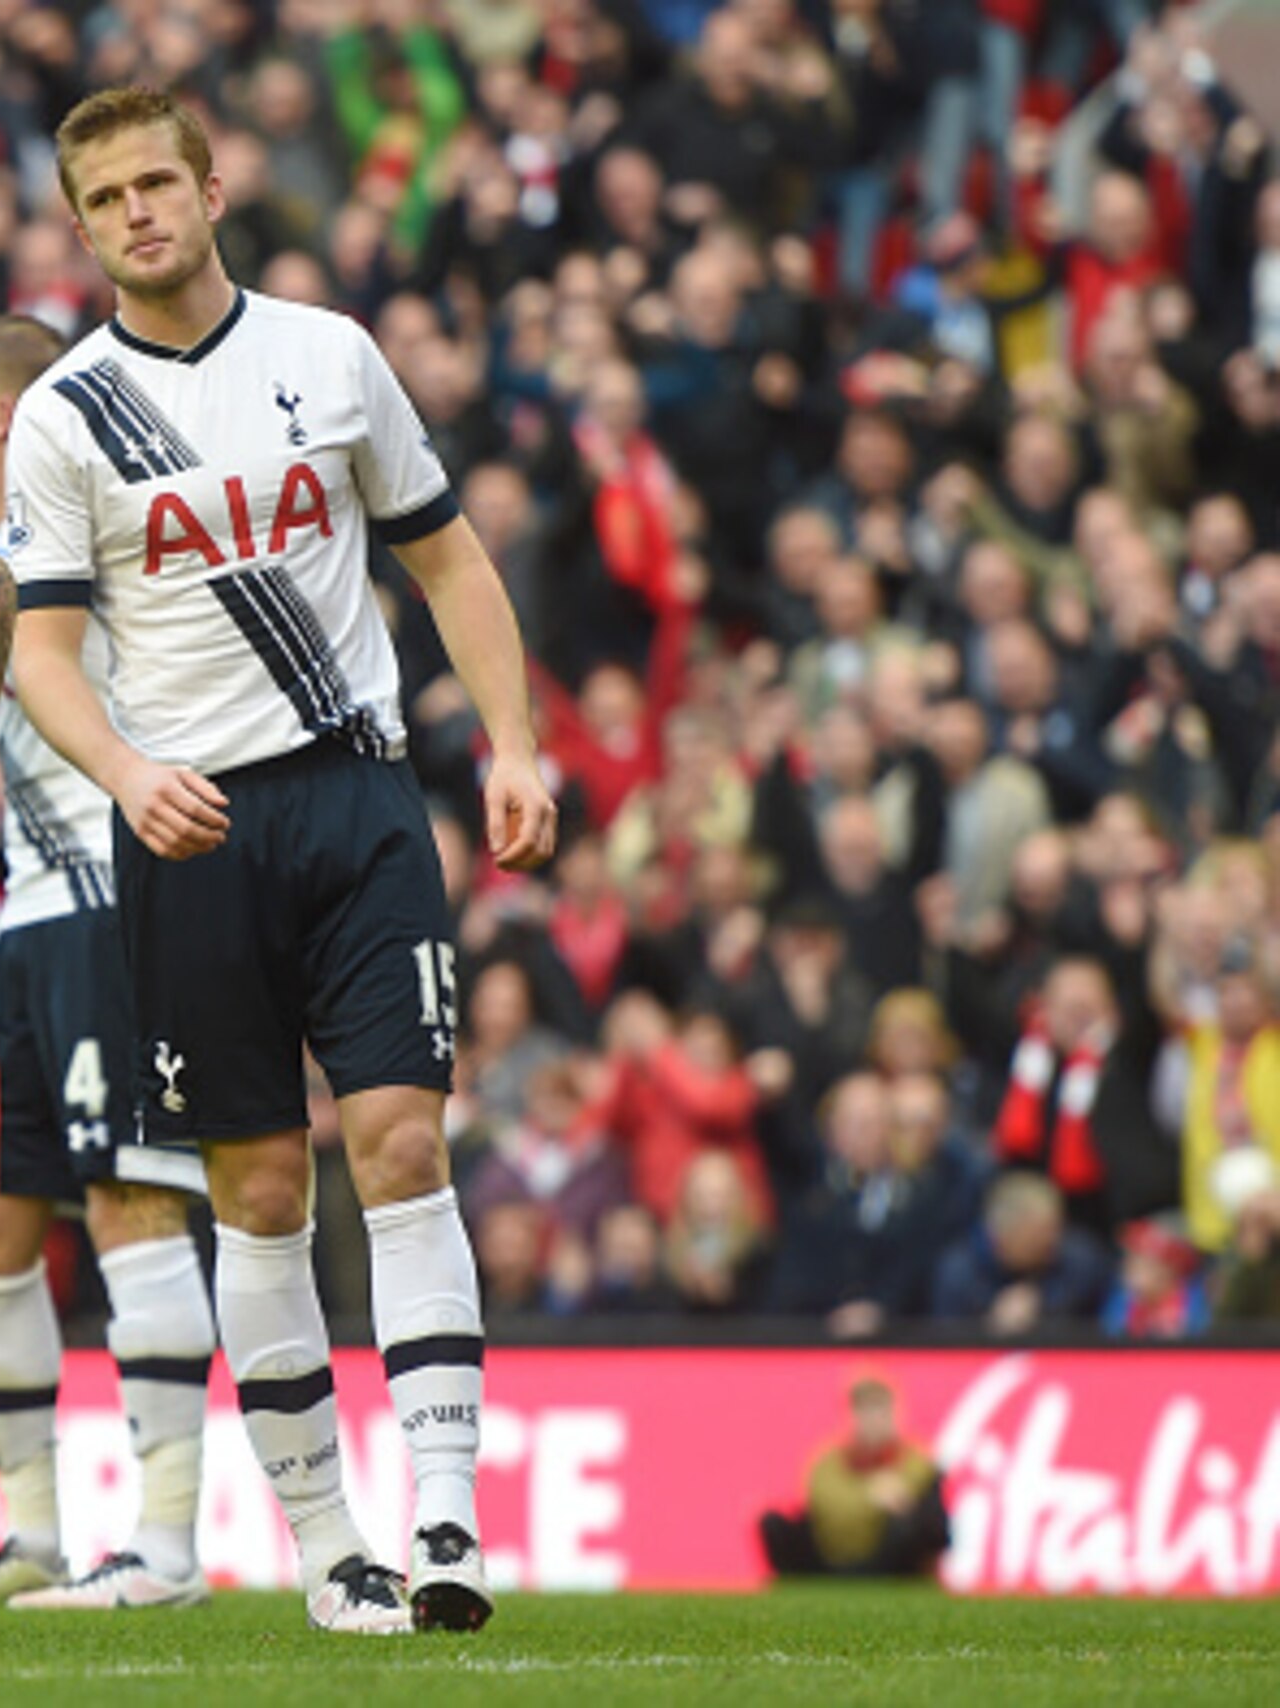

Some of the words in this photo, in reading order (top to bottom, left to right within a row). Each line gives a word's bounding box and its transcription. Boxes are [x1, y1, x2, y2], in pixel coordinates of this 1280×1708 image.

[142, 461, 334, 576] AIA
[412, 938, 457, 1029] 15
[63, 1037, 108, 1118] 4
